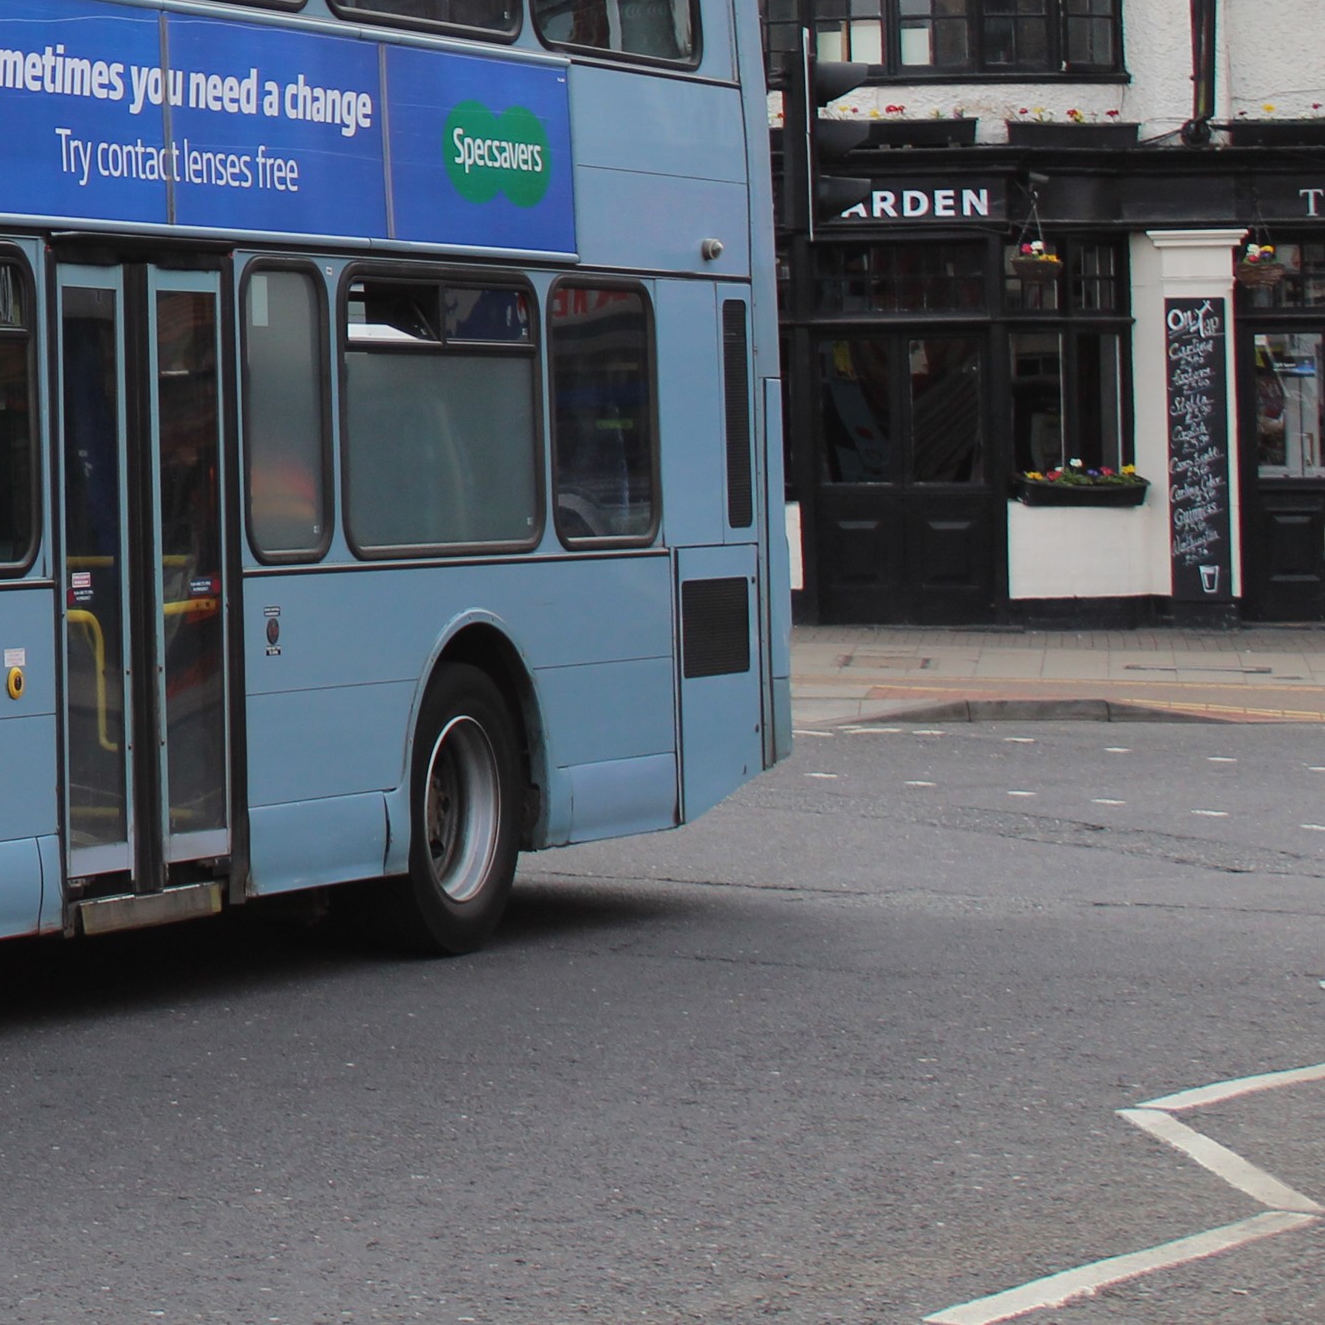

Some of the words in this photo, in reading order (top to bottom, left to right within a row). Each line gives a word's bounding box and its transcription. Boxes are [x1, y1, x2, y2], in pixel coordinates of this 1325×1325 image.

[129, 64, 184, 114] you
[188, 68, 257, 115] need
[263, 80, 279, 117] a
[284, 74, 373, 137] change
[55, 128, 93, 186] Try
[97, 137, 181, 182] contact
[182, 138, 253, 188] lenses
[255, 145, 300, 192] free
[453, 127, 544, 174] Specsavers
